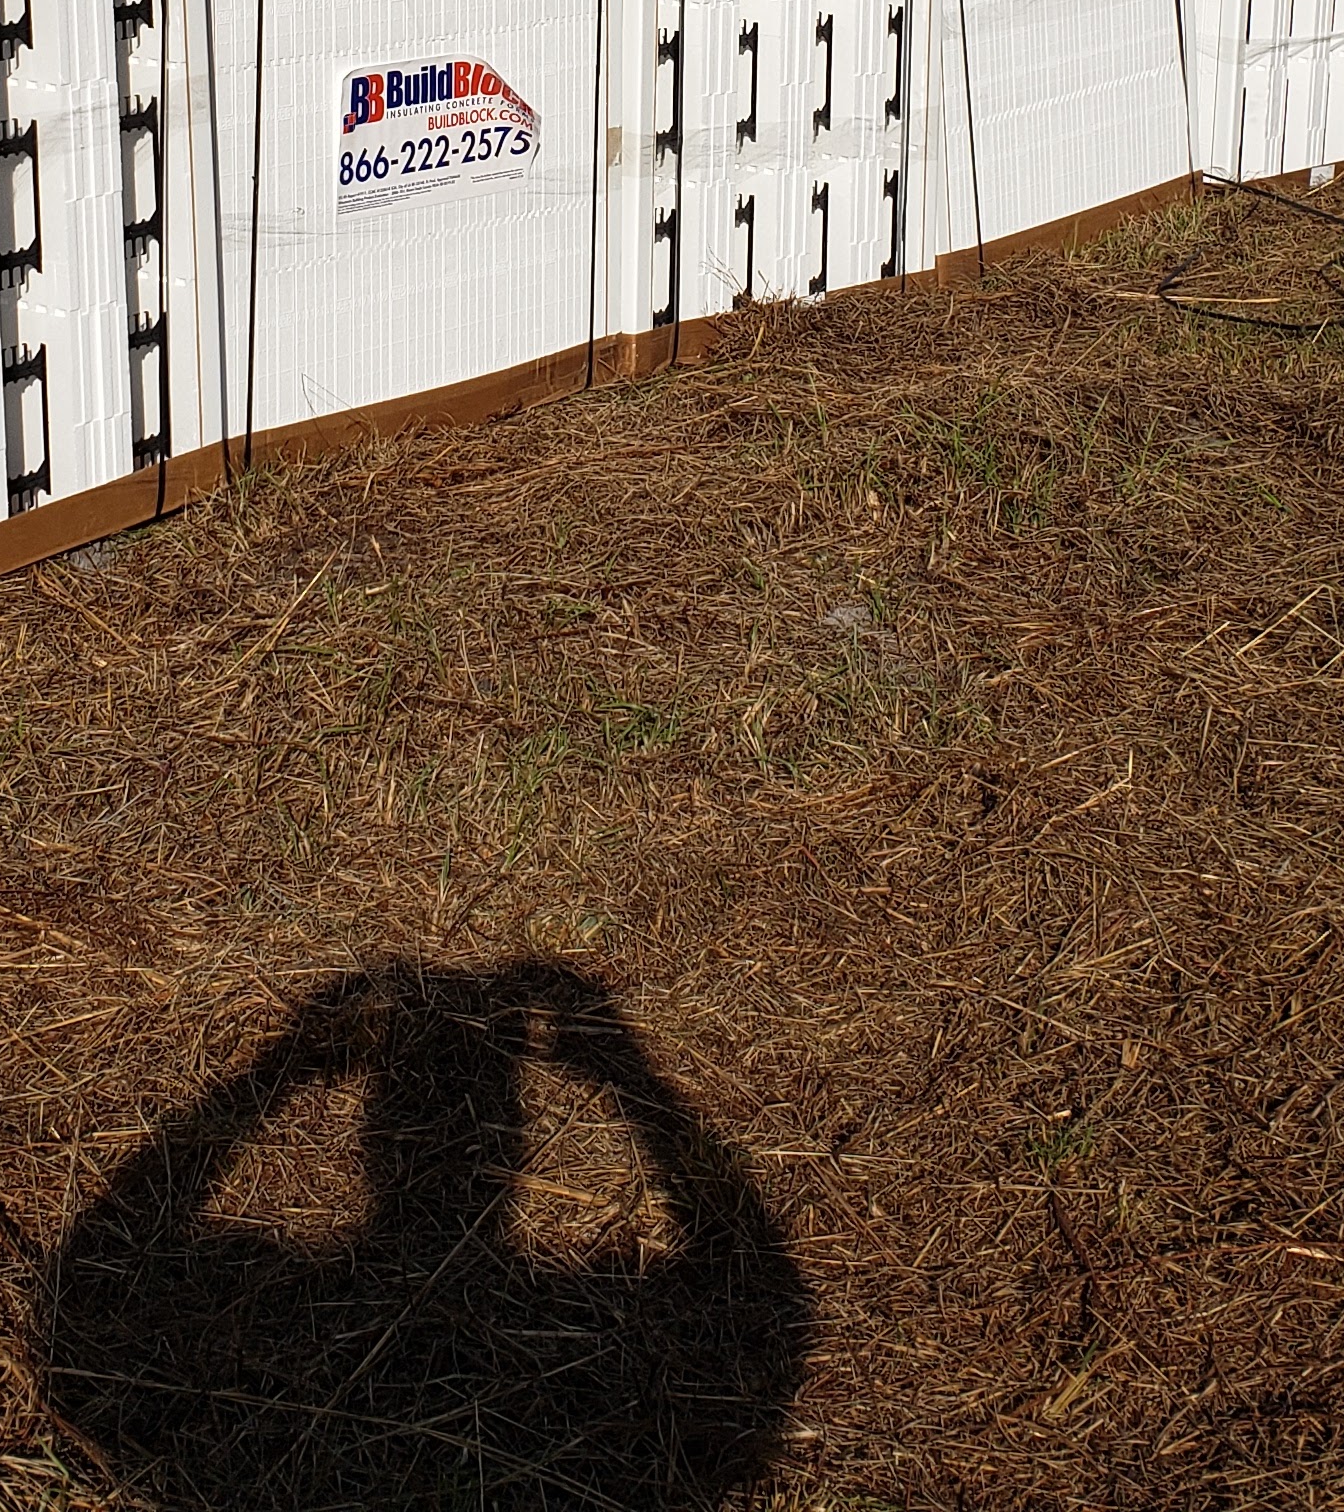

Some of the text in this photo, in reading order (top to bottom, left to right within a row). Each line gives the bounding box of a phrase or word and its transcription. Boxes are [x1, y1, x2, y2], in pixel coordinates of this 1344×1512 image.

[386, 103, 441, 119] INSULATING
[446, 96, 494, 110] CONCRETE
[427, 107, 533, 131] BUILDBLOCK.COM
[339, 126, 533, 186] 866-222-2575
